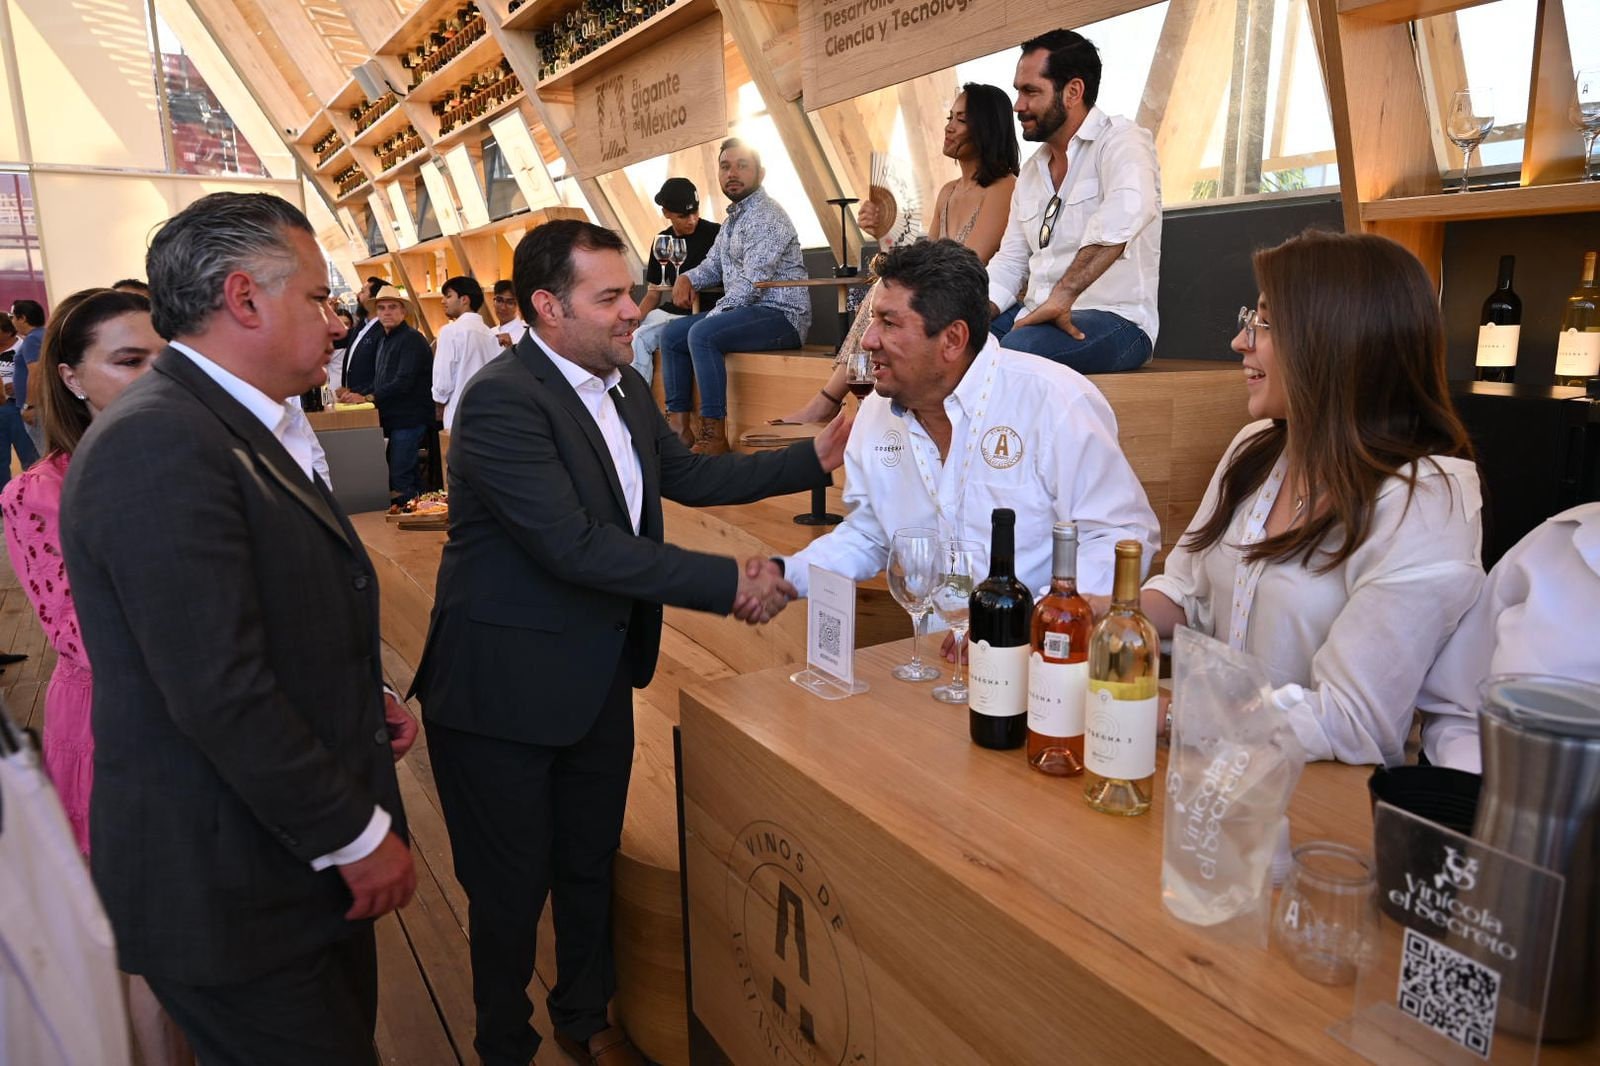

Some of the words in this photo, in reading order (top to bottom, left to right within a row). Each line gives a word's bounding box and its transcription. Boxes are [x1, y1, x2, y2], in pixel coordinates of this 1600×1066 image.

[825, 24, 874, 57] Ciencia
[878, 19, 887, 41] y
[892, 0, 972, 31] Tecnolog
[631, 73, 680, 117] gigante
[640, 104, 687, 139] México
[994, 434, 1009, 457] A
[746, 832, 804, 873] VINOS
[817, 884, 844, 932] DE
[1196, 853, 1217, 880] el
[1284, 899, 1299, 929] A
[1388, 889, 1412, 911] el
[1414, 898, 1518, 961] Secreto
[1404, 872, 1503, 935] Vinícola
